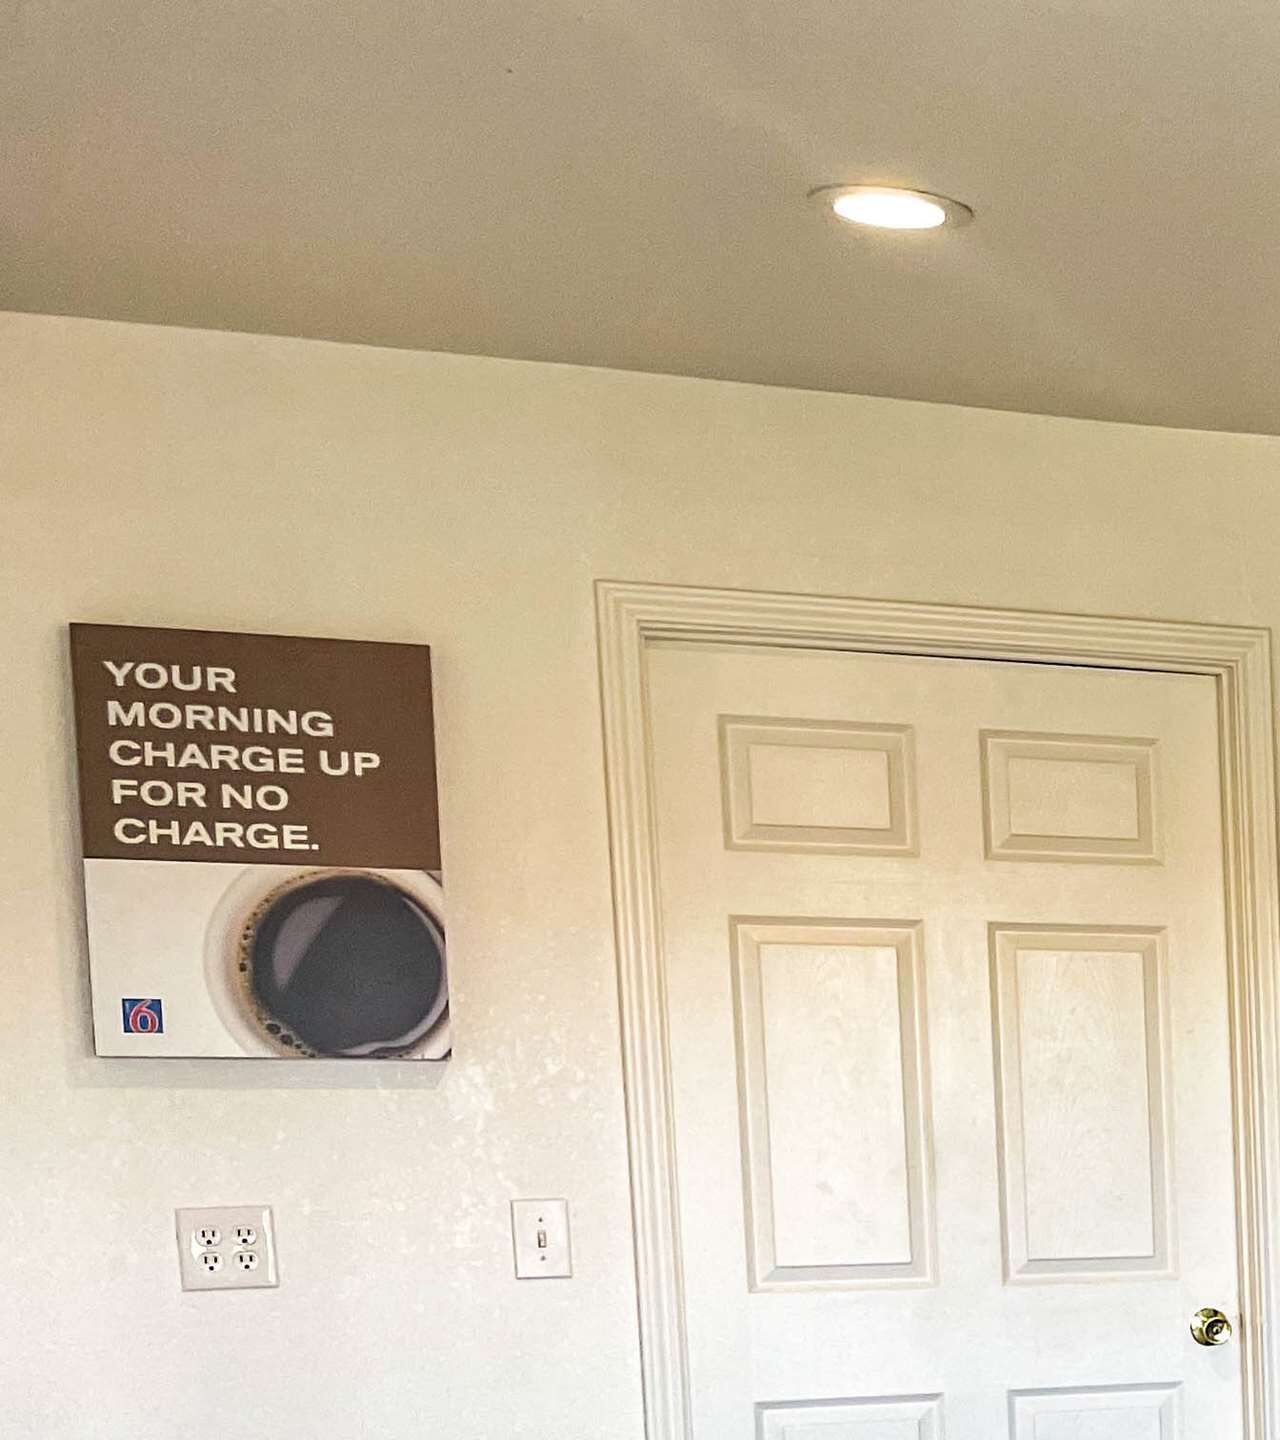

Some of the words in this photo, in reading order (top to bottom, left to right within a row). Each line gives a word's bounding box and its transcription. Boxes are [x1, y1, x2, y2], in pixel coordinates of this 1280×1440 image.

[104, 661, 237, 693] YOUR
[107, 700, 334, 738] MORNING
[109, 740, 305, 774] CHARGE
[318, 750, 381, 777] UP
[112, 779, 206, 808] FOR
[222, 784, 288, 812] NO
[114, 817, 320, 851] CHARGE.
[129, 1000, 159, 1033] 6
